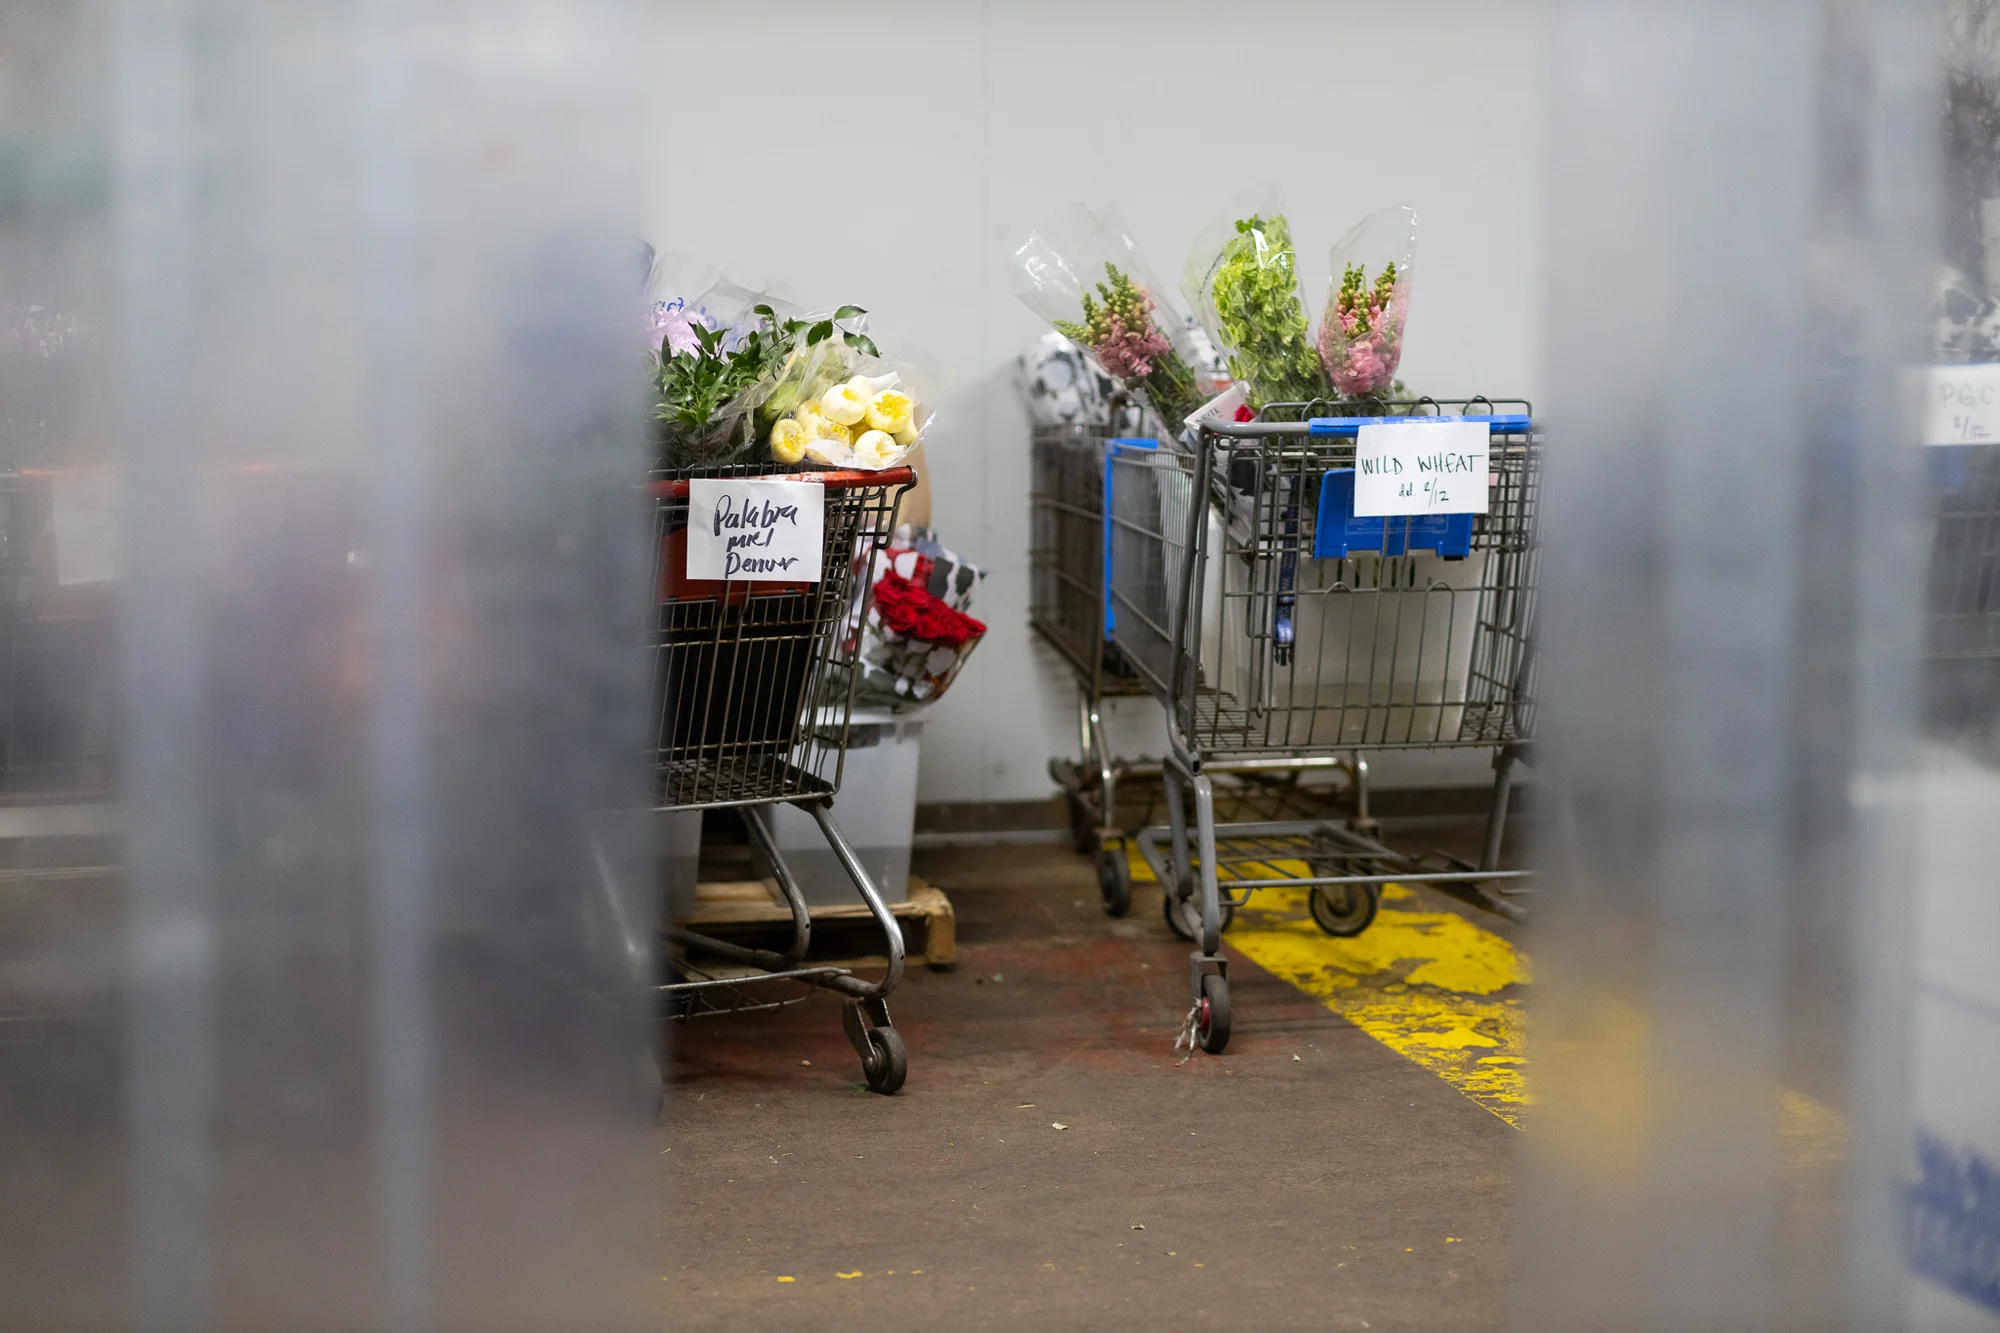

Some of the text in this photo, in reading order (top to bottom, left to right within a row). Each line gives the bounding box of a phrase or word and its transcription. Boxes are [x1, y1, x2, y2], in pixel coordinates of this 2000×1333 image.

[1361, 452, 1484, 475] WILD WHEAT
[1424, 478, 1449, 508] 2/12
[713, 494, 798, 537] Palabra
[725, 552, 799, 579] Denver
